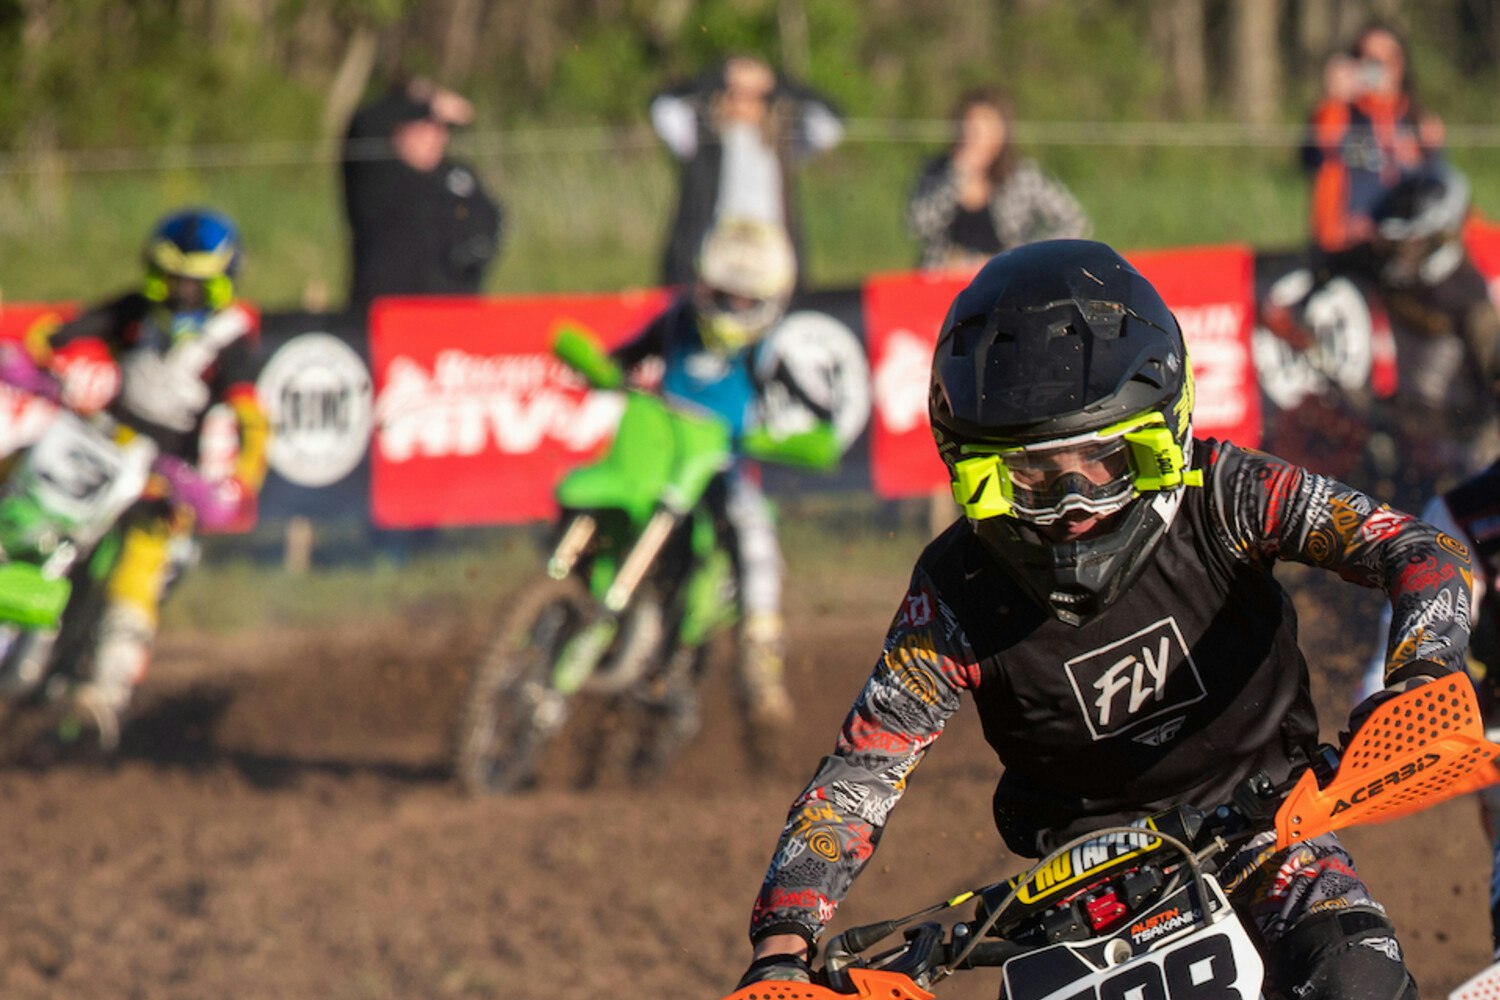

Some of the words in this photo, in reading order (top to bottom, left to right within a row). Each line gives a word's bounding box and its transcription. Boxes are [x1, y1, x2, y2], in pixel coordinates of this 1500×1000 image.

[1093, 637, 1170, 726] FLY
[1330, 752, 1441, 818] ACERBIS
[1131, 906, 1178, 935] AUSTIN
